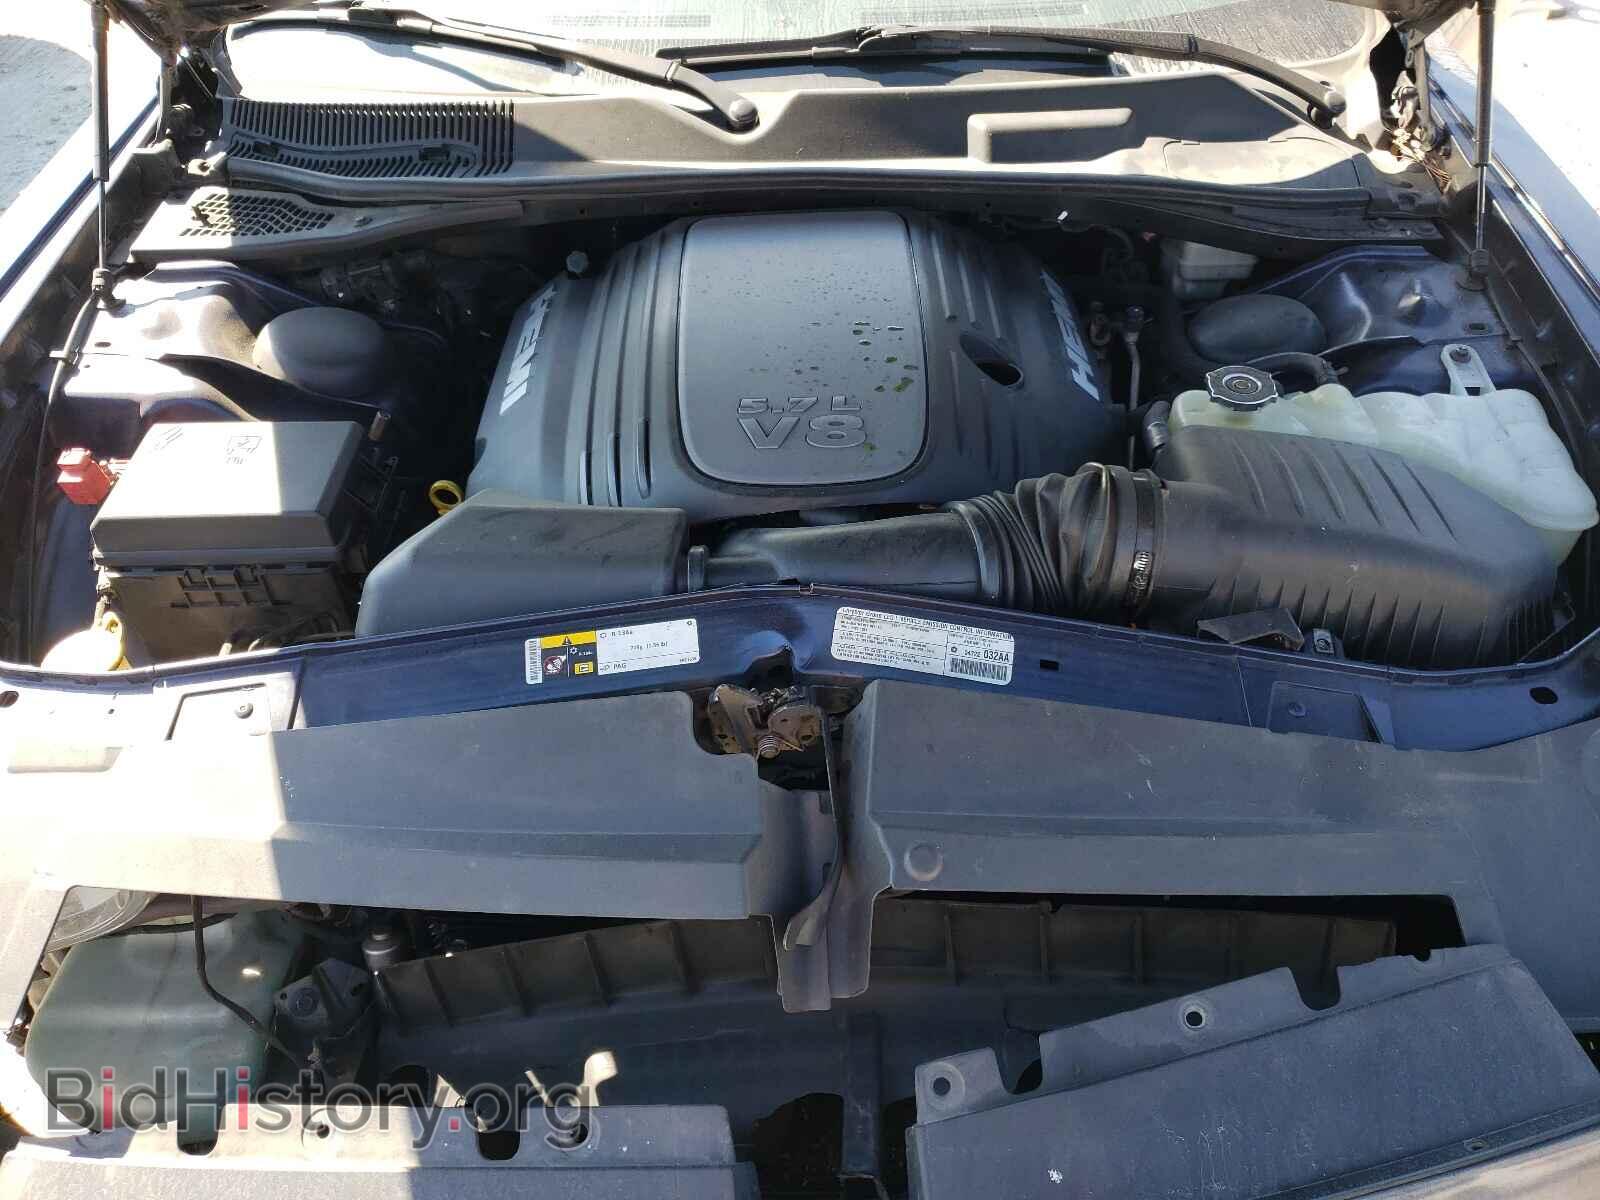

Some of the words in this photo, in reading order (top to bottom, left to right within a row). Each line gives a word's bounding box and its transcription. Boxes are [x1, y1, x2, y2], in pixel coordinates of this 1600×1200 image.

[499, 284, 558, 415] HEMI
[737, 413, 868, 450] V8
[922, 620, 948, 629] EMISSION
[949, 623, 974, 633] CONTROL
[975, 627, 1013, 640] INFORMATION
[983, 649, 1011, 663] 032AA
